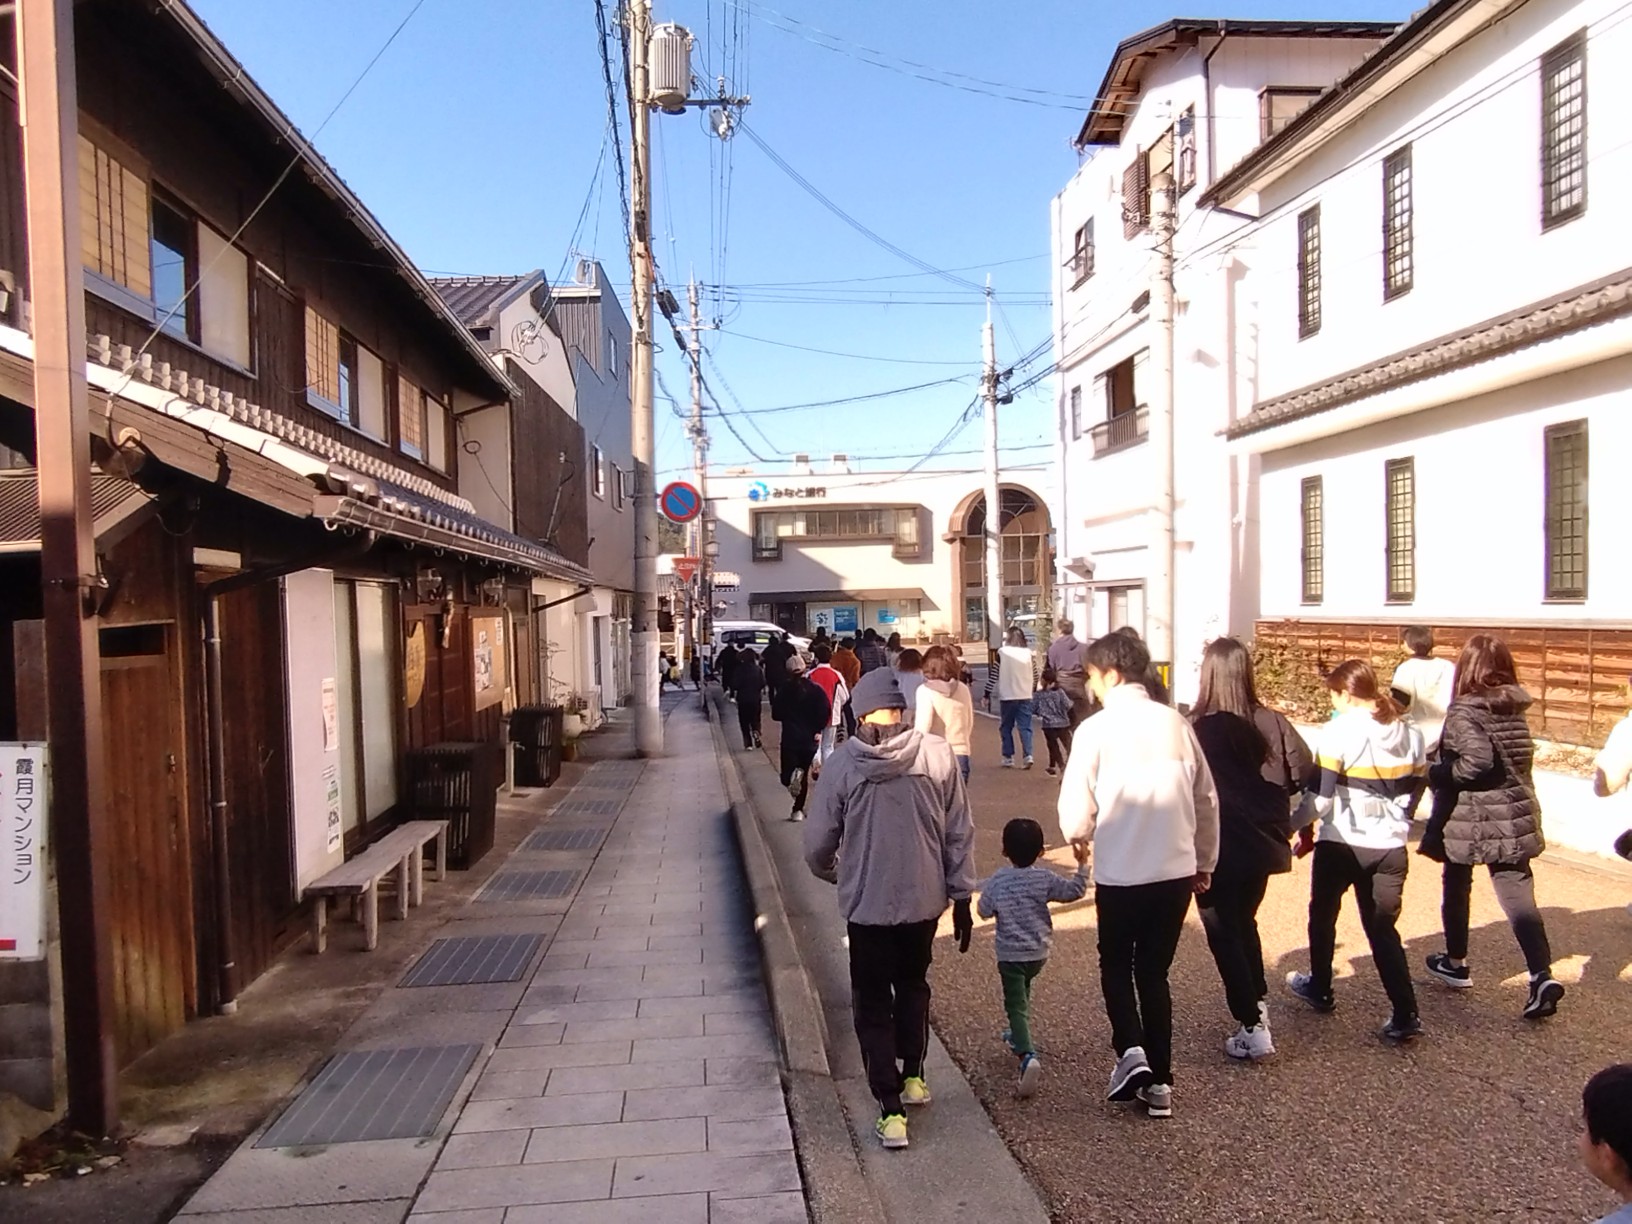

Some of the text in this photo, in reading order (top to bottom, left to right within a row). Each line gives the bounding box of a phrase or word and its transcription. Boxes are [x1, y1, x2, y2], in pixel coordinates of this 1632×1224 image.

[773, 486, 827, 498] みなと銀行
[13, 757, 34, 884] 霞月マンション
